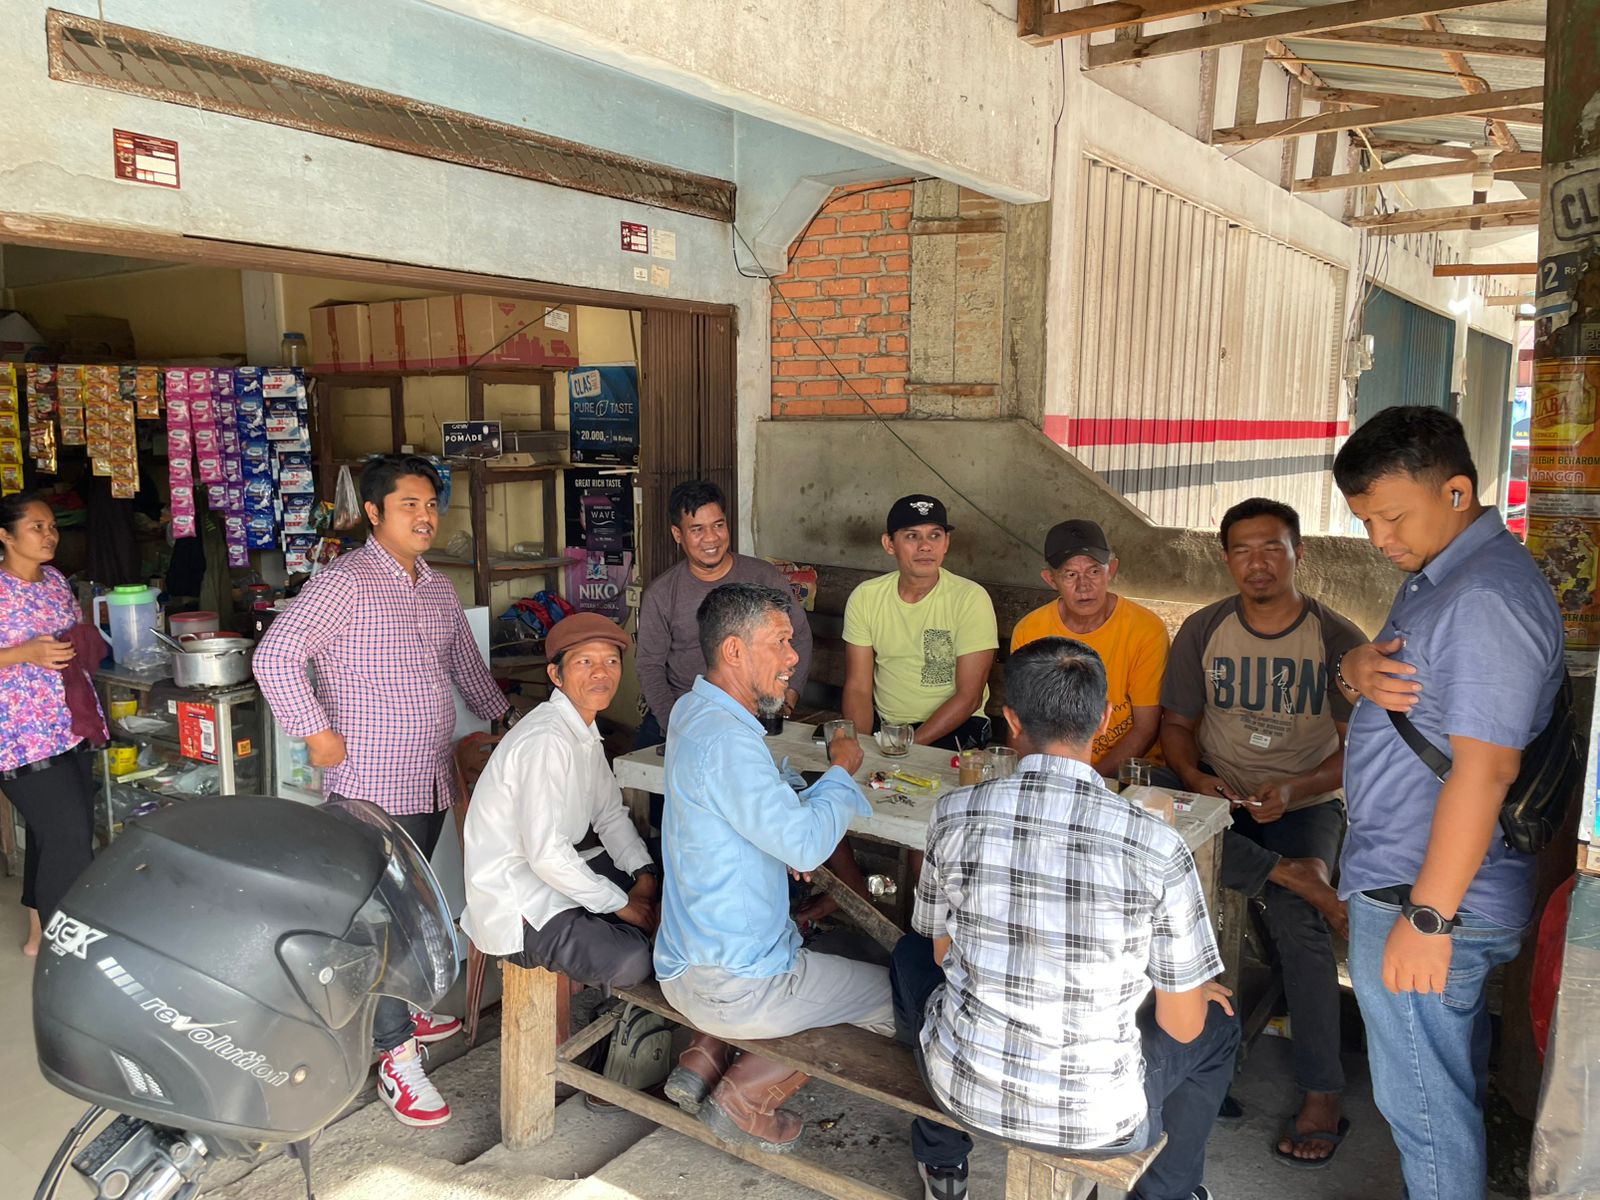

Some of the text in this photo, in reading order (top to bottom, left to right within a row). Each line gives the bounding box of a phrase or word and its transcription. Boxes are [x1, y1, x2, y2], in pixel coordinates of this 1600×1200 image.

[1560, 184, 1600, 230] CL
[574, 375, 592, 396] CLAS
[573, 402, 634, 414] PURE TASTE
[445, 433, 483, 443] POMADE
[574, 479, 622, 488] GREAT RICH TASTE
[590, 510, 616, 520] WAVE
[578, 583, 620, 601] NIKO
[1213, 656, 1328, 716] BURN
